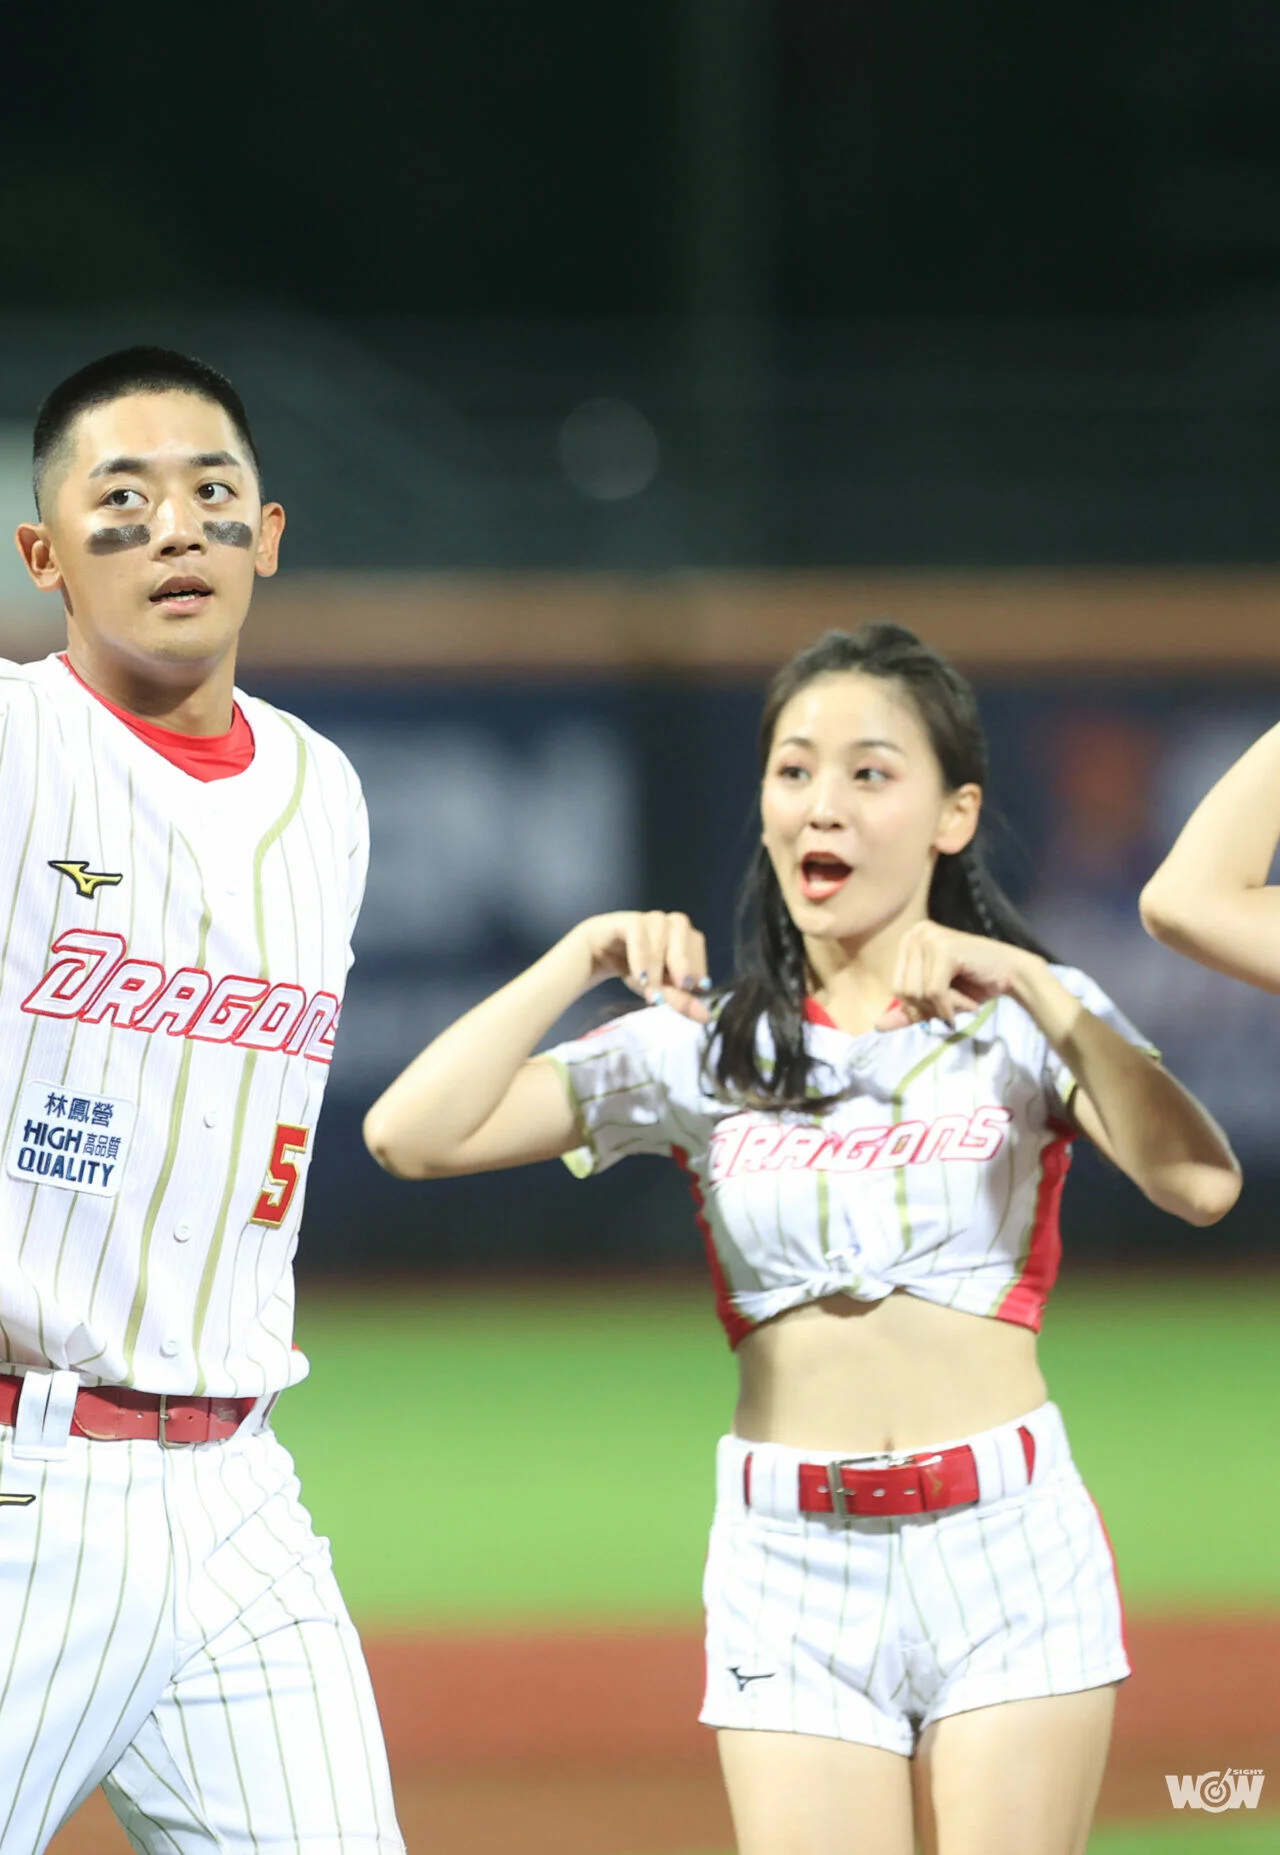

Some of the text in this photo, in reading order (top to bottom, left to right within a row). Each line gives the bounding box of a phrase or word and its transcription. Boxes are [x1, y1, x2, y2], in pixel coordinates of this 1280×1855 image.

[44, 1092, 114, 1127] 林鳳營
[23, 1119, 122, 1160] HIGH 高品質
[17, 1146, 115, 1188] QUALITY
[250, 1122, 309, 1227] 5
